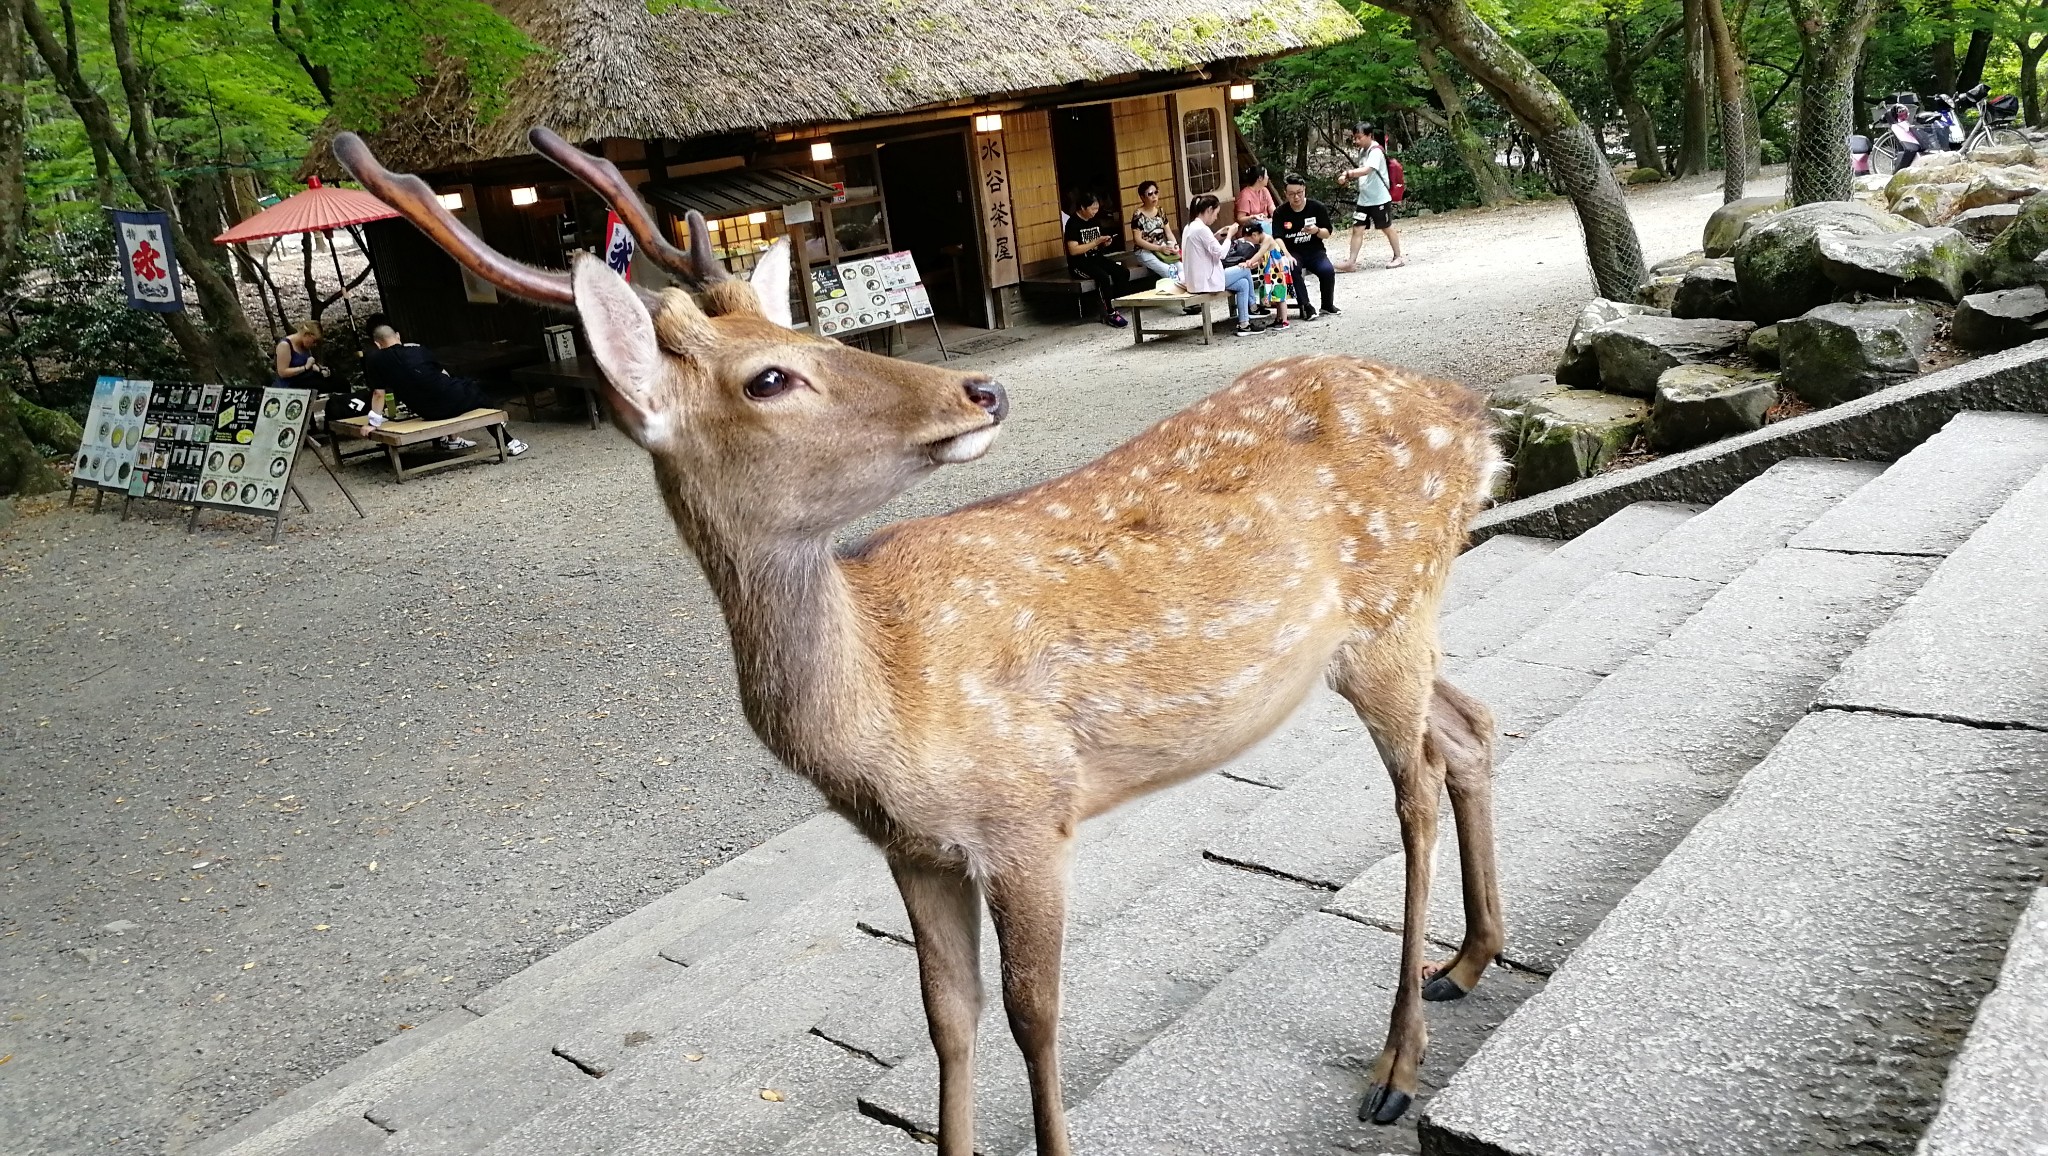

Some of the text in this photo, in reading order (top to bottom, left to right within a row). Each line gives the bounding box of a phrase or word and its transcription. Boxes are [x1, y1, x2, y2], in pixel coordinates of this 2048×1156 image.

[981, 138, 1013, 262] 水谷茶屋
[132, 240, 166, 282] 氷
[223, 389, 249, 403] うどん
